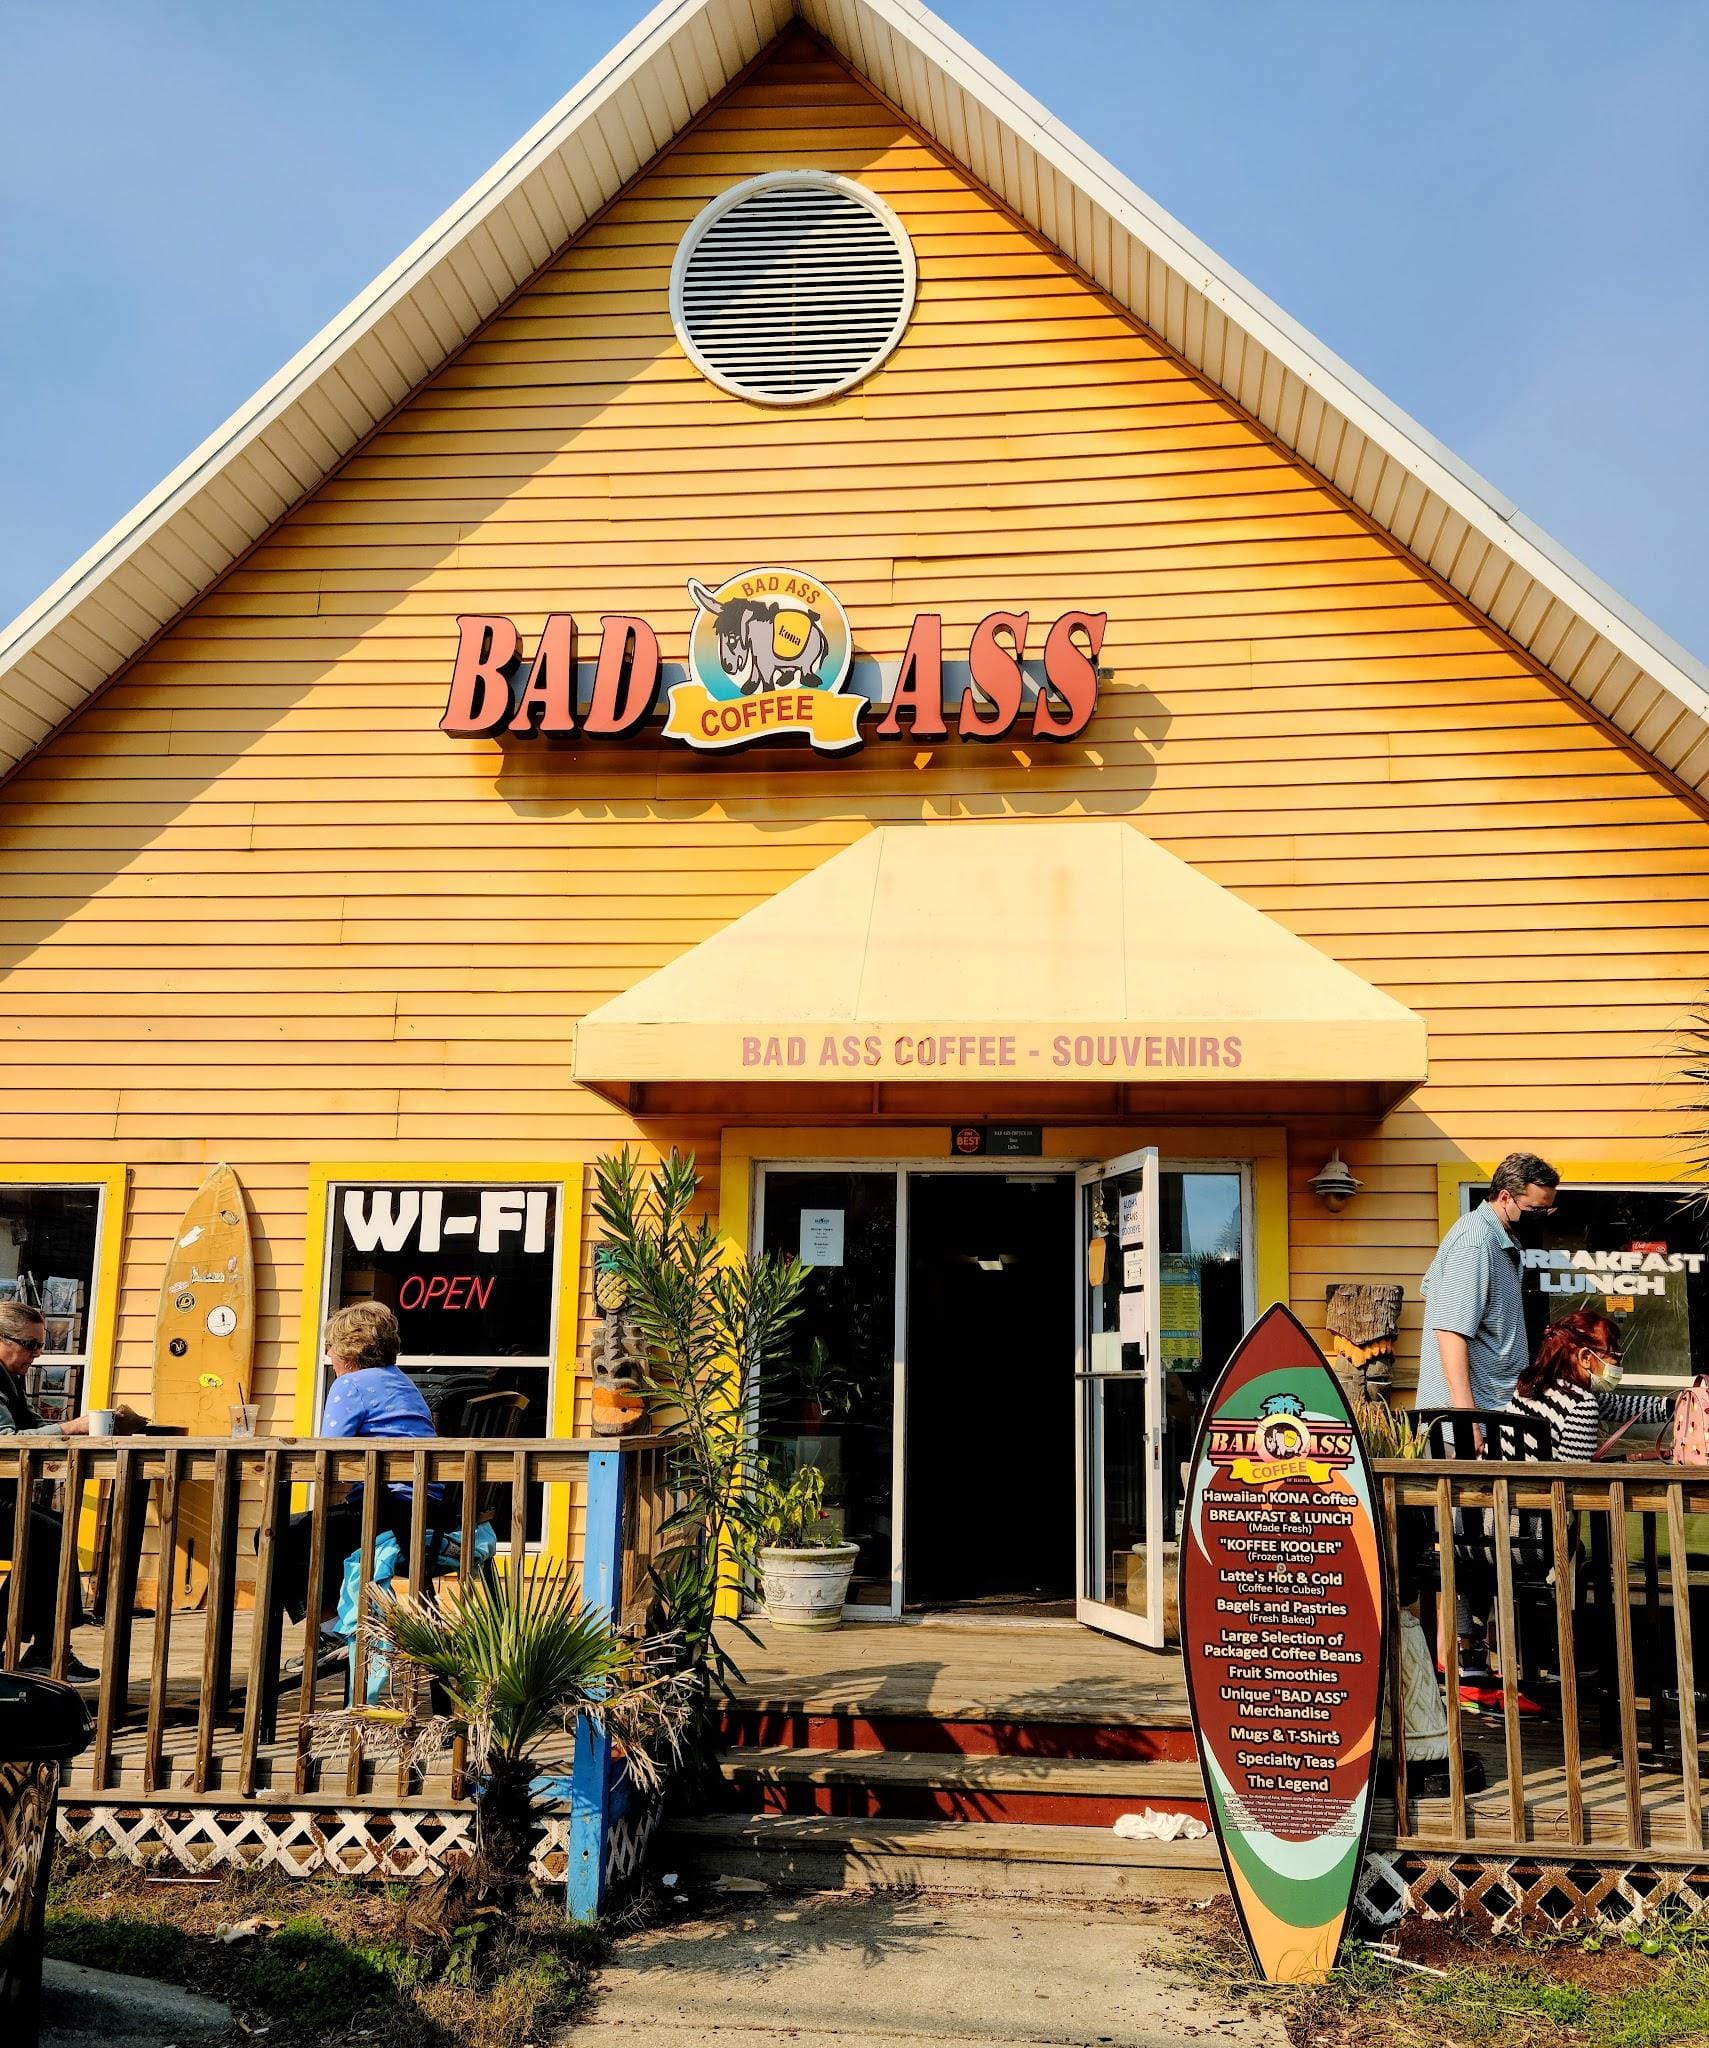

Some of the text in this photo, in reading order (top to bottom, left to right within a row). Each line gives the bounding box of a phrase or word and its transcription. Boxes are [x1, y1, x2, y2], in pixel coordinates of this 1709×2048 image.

[741, 577, 820, 604] BAD ASS
[779, 625, 801, 646] kona
[439, 611, 1107, 739] BAD ASS
[702, 695, 814, 736] COFFEE
[743, 1036, 806, 1066] BAD
[819, 1036, 882, 1066] ASS
[895, 1036, 1016, 1066] COFFEE
[1053, 1035, 1243, 1067] SOUVENIRS
[957, 1136, 981, 1146] BEST
[344, 1190, 548, 1253] WI-FI
[1540, 1272, 1665, 1296] LUNCH
[399, 1275, 496, 1310] OPEN
[1252, 1461, 1307, 1479] COFFEE
[1203, 1490, 1357, 1505] Hawaiian KONA Coffee
[1210, 1511, 1351, 1524] BREAKFAST & LUNCH
[1248, 1523, 1312, 1534] (Made Fresh)
[1220, 1538, 1341, 1553] "KOFFEE KOOLER"
[1249, 1551, 1313, 1563] (Frozen Latte)
[1221, 1571, 1342, 1585] Latte's Hot & Cold
[1238, 1584, 1325, 1595] (Coffee Ice Cubes)
[1217, 1600, 1347, 1615] Bagels and Pastries
[1250, 1614, 1314, 1625] (Fresh Baked)
[1222, 1630, 1343, 1645] Large Selection of
[1205, 1645, 1361, 1663] Packaged Coffee Beans
[1230, 1666, 1337, 1682] Fruit Smoothies
[1221, 1688, 1347, 1704] Unique "BAD ASS"
[1240, 1704, 1329, 1720] Merchandise
[1231, 1727, 1268, 1742] Mugs
[1272, 1728, 1284, 1741] &
[1238, 1752, 1335, 1769] Specialty Teas
[1248, 1775, 1329, 1792] The Legend
